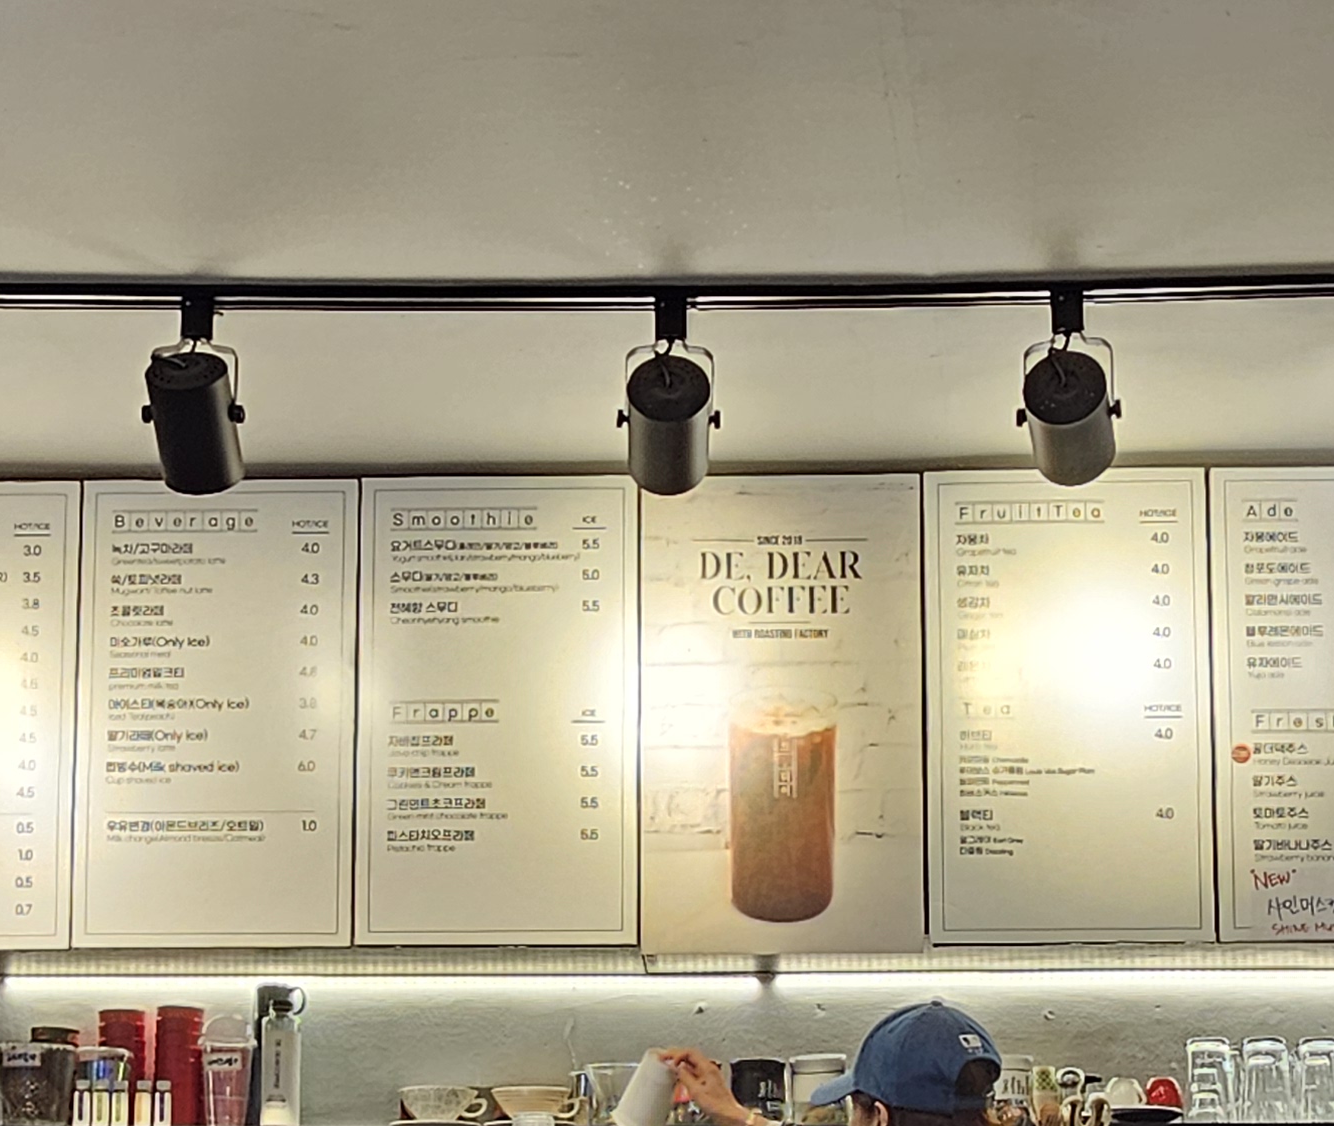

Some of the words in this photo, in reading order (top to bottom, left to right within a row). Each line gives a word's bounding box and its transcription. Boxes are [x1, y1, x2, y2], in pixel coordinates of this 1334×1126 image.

[1246, 504, 1293, 517] Ade
[114, 514, 254, 531] Beverage
[392, 512, 534, 527] Smoothie
[756, 536, 779, 545] SINCE
[781, 536, 803, 545] 2018
[1150, 531, 1169, 543] 4.0
[23, 545, 42, 557] 3.0
[301, 542, 320, 554] 4.0
[699, 551, 752, 582] DE,
[766, 550, 863, 580] DEAR
[1151, 563, 1170, 575] 4.0
[23, 571, 41, 583] 3.5
[582, 600, 600, 612] 5.5
[712, 585, 851, 616] COFFEE
[300, 604, 319, 615] 4.0
[425, 601, 458, 613] 스무디
[392, 706, 495, 722] Frappe
[1154, 727, 1173, 740] 4.0
[168, 760, 215, 773] shaved
[297, 760, 316, 772] 6.0
[580, 765, 599, 777] 5.5
[1252, 774, 1298, 787] 딸기주스
[580, 797, 599, 809] 5.5
[1155, 807, 1174, 820] 4.0
[1252, 807, 1309, 819] 토마토주스
[1253, 839, 1333, 851] 딸기바나나주스
